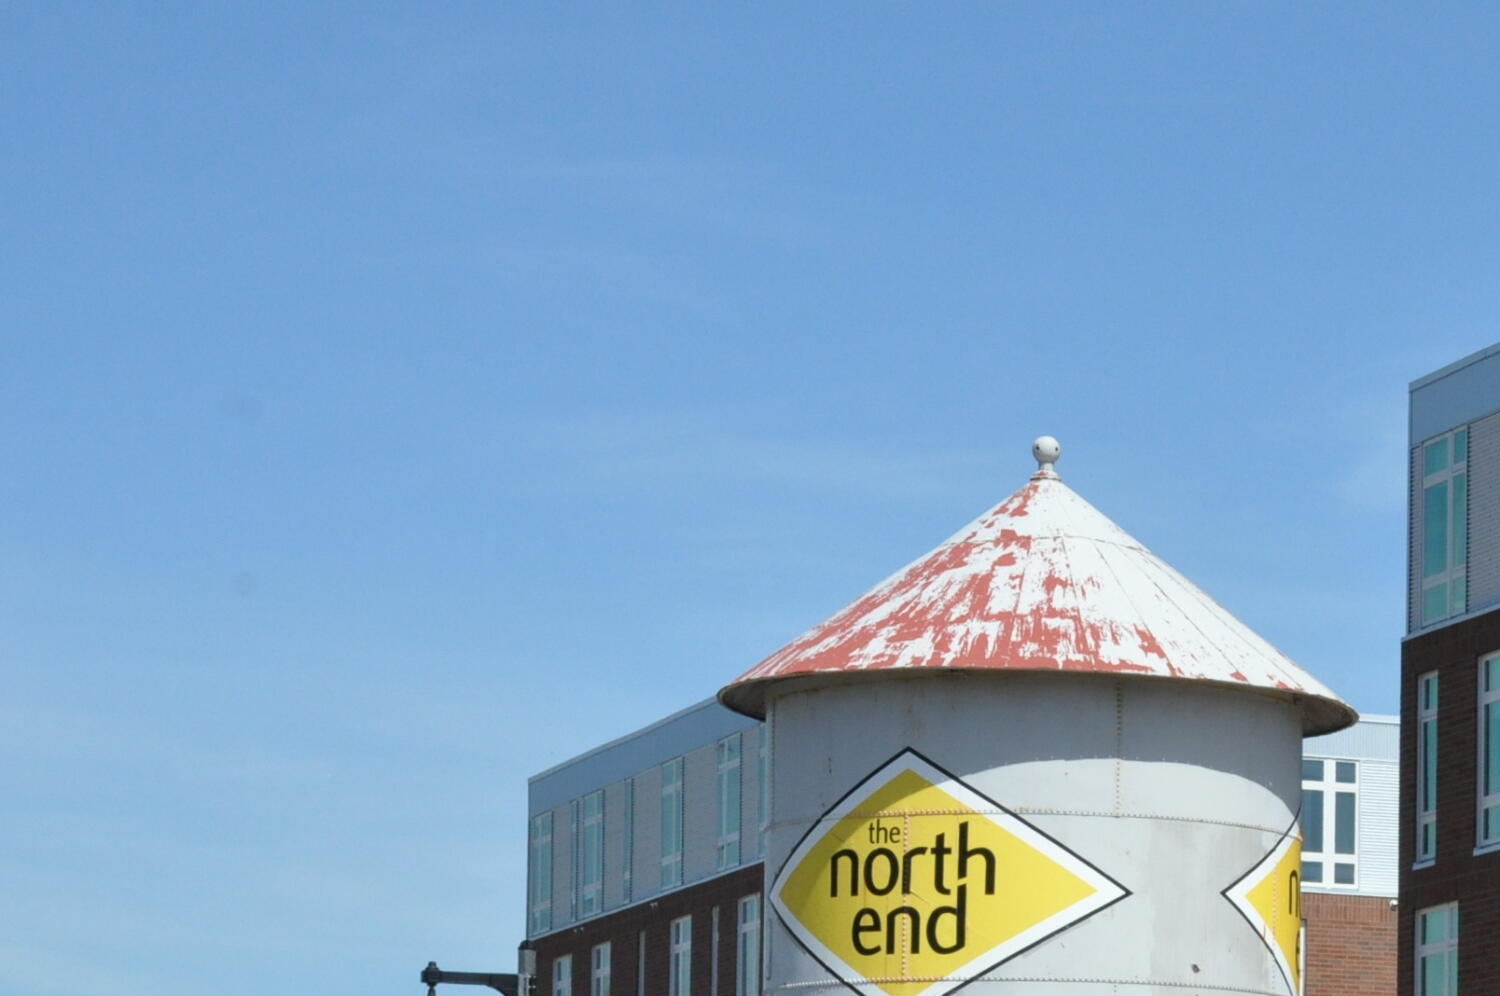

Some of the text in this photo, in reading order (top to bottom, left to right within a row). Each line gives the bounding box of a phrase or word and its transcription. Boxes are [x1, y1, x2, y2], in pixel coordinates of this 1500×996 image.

[830, 821, 997, 898] north
[868, 819, 901, 844] the
[852, 883, 967, 956] end
